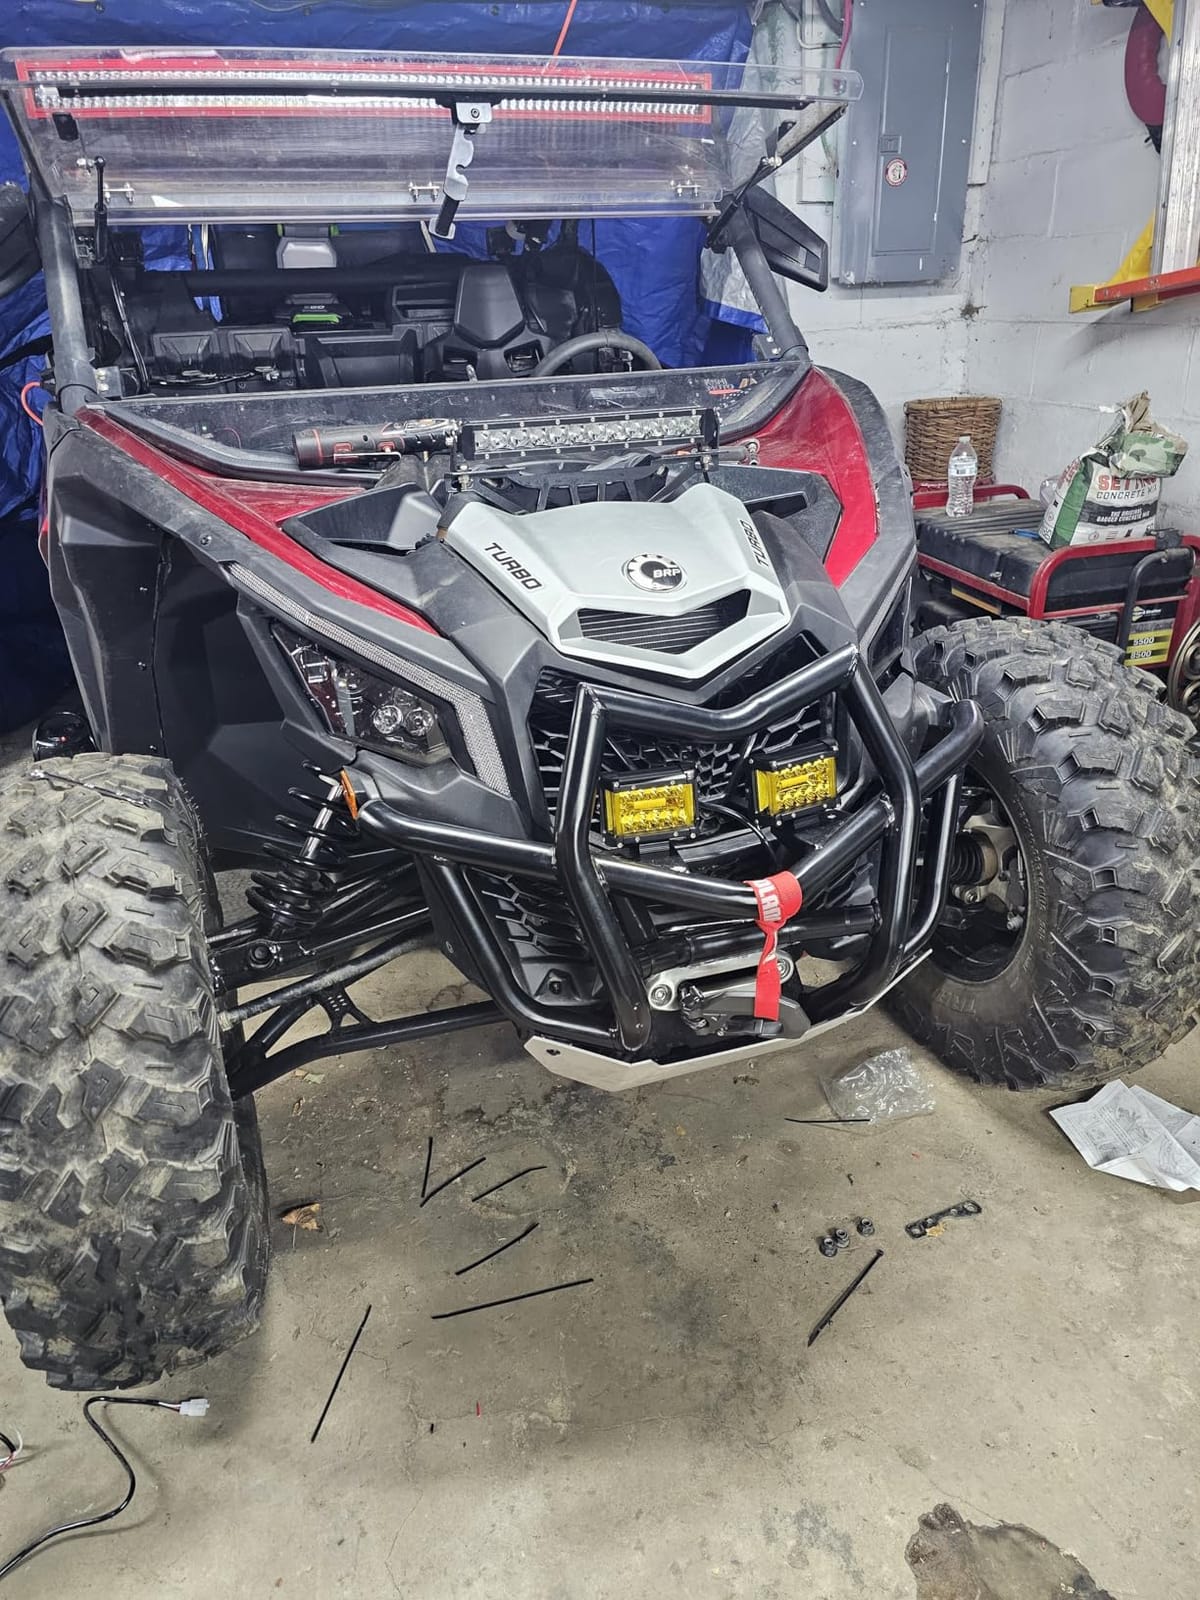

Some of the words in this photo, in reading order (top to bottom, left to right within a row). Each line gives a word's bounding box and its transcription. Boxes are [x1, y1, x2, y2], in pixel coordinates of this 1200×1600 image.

[1096, 487, 1145, 500] CONCRETE
[740, 519, 770, 567] TURBO
[484, 542, 543, 591] TURBO
[653, 567, 681, 578] BRP
